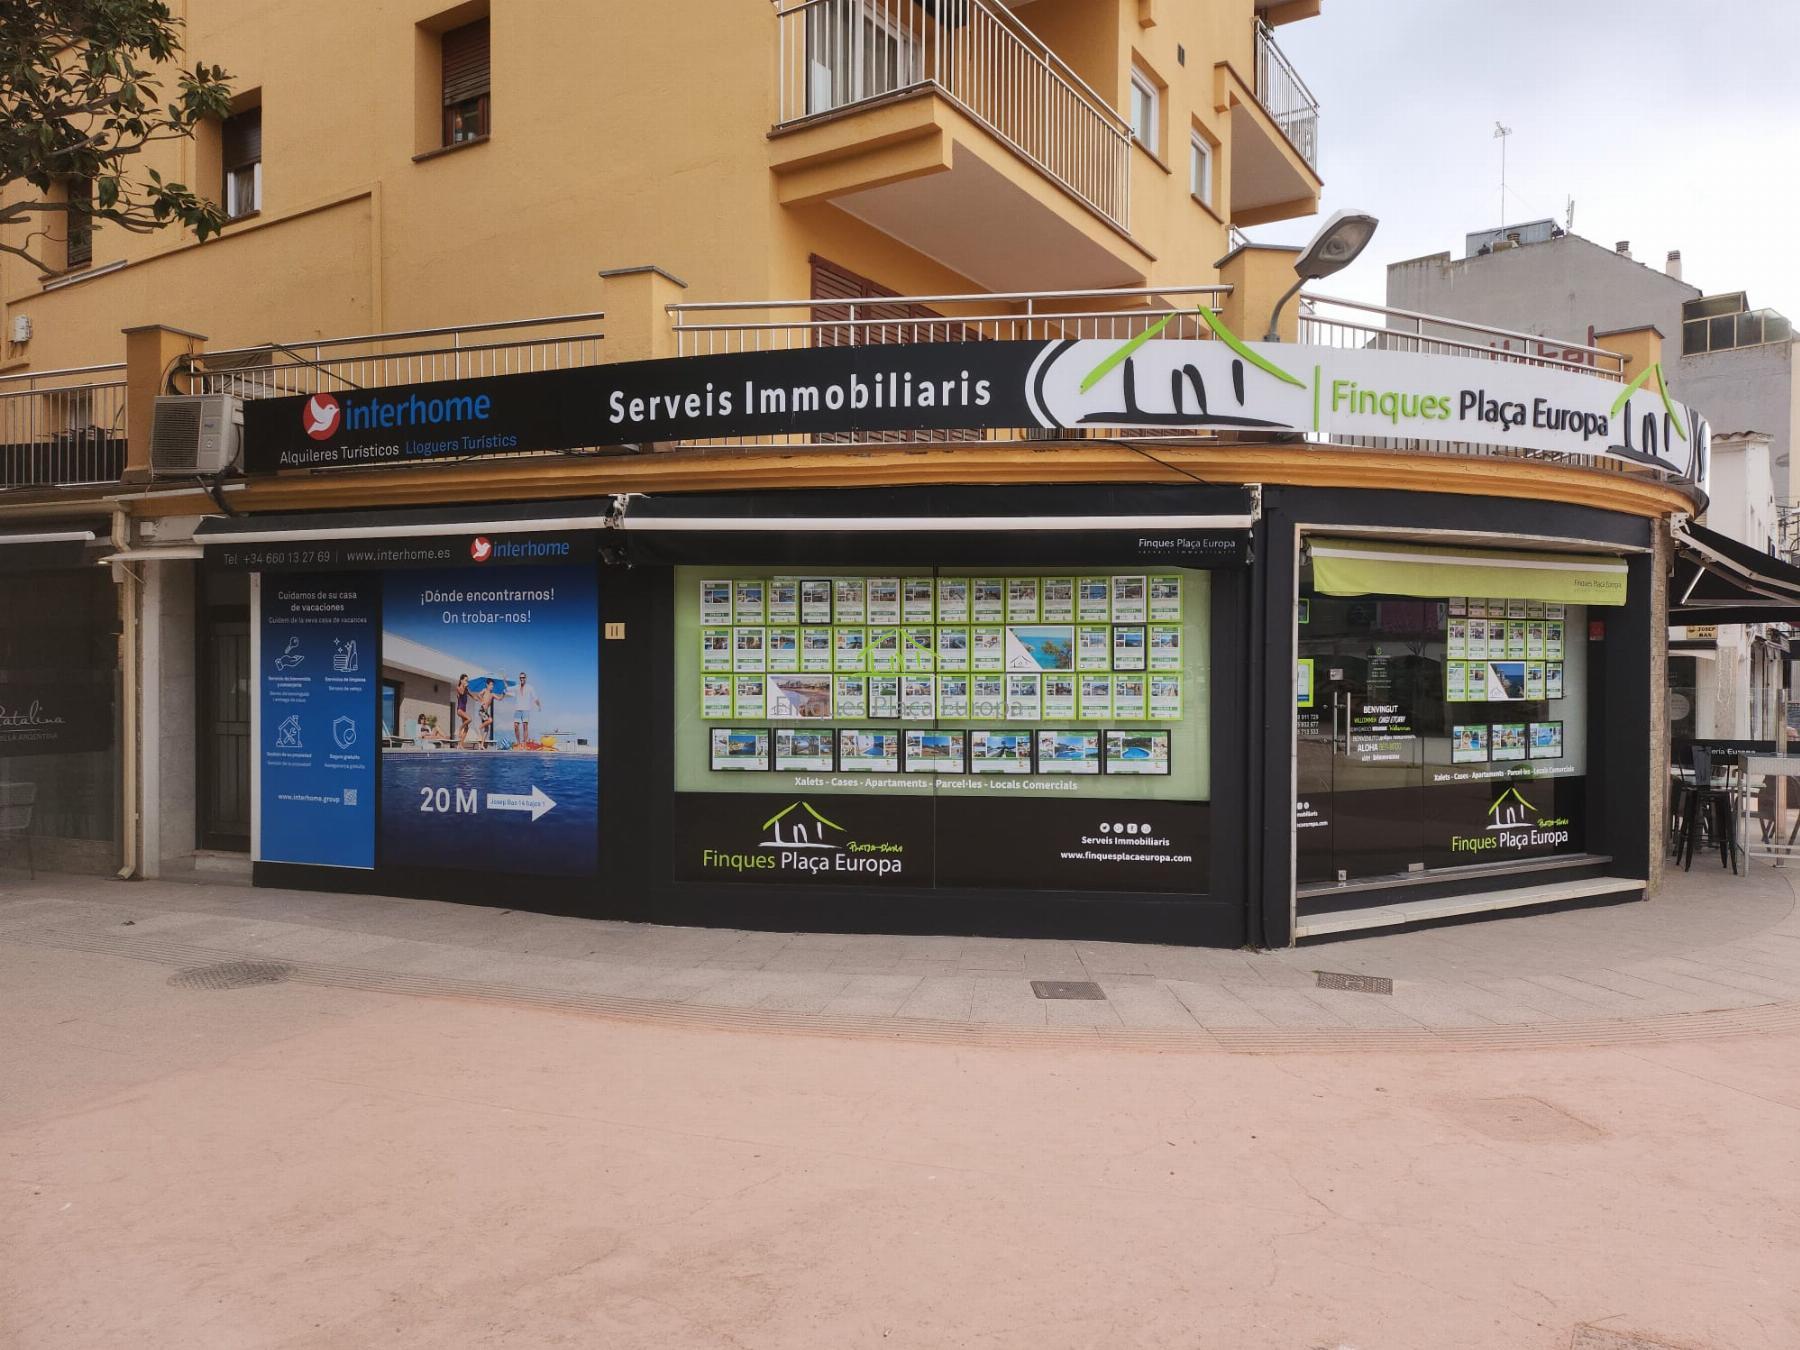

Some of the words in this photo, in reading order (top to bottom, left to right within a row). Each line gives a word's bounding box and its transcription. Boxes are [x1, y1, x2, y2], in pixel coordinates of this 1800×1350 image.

[609, 382, 732, 424] Serveis
[746, 370, 991, 414] Immobiliaris
[346, 394, 491, 430] interhome
[1332, 379, 1451, 424] Finques
[1459, 389, 1526, 431] Plaça
[1533, 397, 1609, 440] Europa
[280, 450, 338, 465] Alquileres
[341, 443, 399, 459] Turísticos
[406, 439, 459, 456] Lloguers
[462, 434, 517, 449] Turístics
[493, 541, 570, 558] interhome
[1138, 538, 1174, 549] Finques
[1177, 538, 1200, 549] Plaça
[1203, 538, 1236, 549] Europa
[243, 553, 262, 564] +34
[266, 552, 285, 563] 660
[288, 552, 298, 563] 13
[302, 551, 314, 563] 27
[317, 551, 330, 562] 69
[347, 548, 450, 560] www.interhome.es
[278, 591, 316, 599] Cuidamos
[317, 591, 327, 599] de
[421, 589, 463, 605] ¡Dónde
[467, 588, 555, 602] encontrarnos!
[291, 603, 300, 611] de
[302, 603, 344, 611] vacaciones
[442, 611, 458, 623] On
[462, 610, 531, 623] trobar-nos!
[874, 695, 933, 720] Plaça
[942, 696, 1023, 720] Europa
[1363, 705, 1398, 713] BENVINGUT
[1357, 743, 1378, 752] ALOHA
[795, 777, 824, 786] Xalets
[831, 777, 858, 787] Cases
[865, 778, 928, 788] Apartaments
[990, 780, 1020, 789] Locals
[1022, 780, 1079, 790] Comercials
[1434, 773, 1450, 781] Xalets
[420, 786, 450, 813] 20
[456, 788, 478, 814] M
[1081, 836, 1113, 845] Serveis
[1115, 836, 1170, 846] Immobiliaris
[1452, 836, 1497, 854] Finques
[1499, 831, 1528, 849] Plaça
[1531, 829, 1568, 846] Europa
[703, 850, 775, 872] Finques
[781, 852, 829, 874] Plaça
[836, 853, 901, 876] Europa
[1060, 851, 1192, 863] www.finquesplacaeuropa.com
